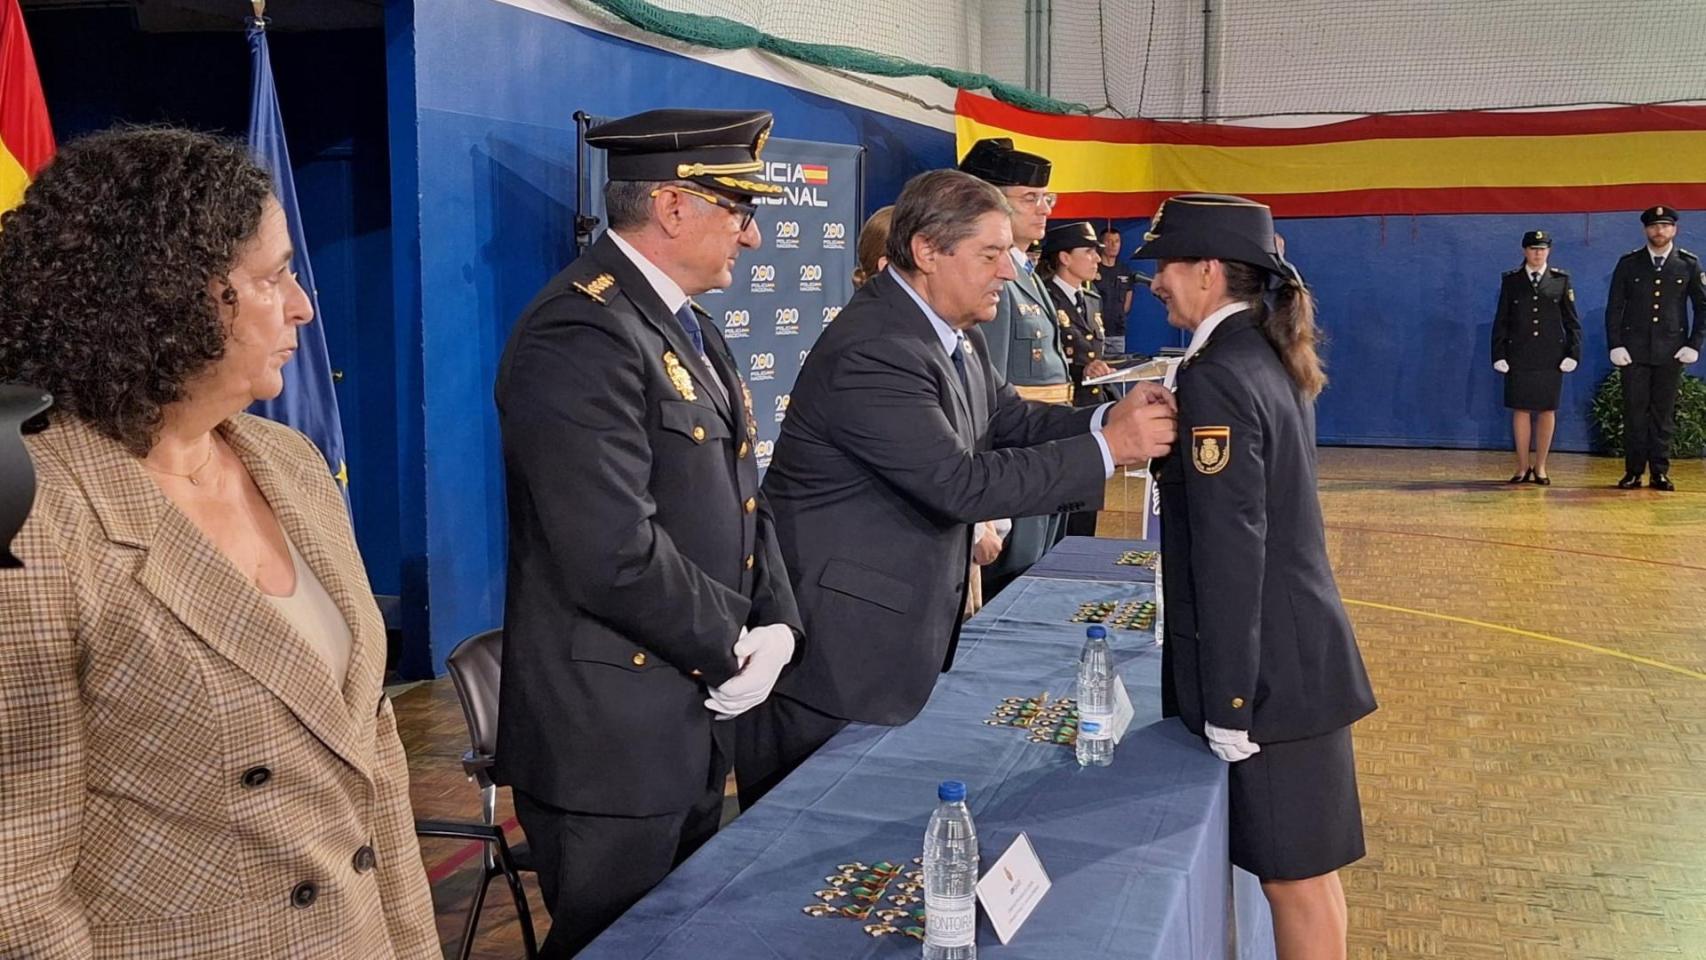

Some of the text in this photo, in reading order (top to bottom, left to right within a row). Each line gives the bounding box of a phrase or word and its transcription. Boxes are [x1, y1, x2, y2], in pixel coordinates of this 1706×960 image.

[776, 221, 800, 238] 200
[823, 222, 845, 239] 200
[751, 264, 775, 281] 200
[799, 264, 822, 281] 200
[724, 309, 750, 328] 200
[775, 308, 799, 325] 200
[750, 352, 775, 371] 200
